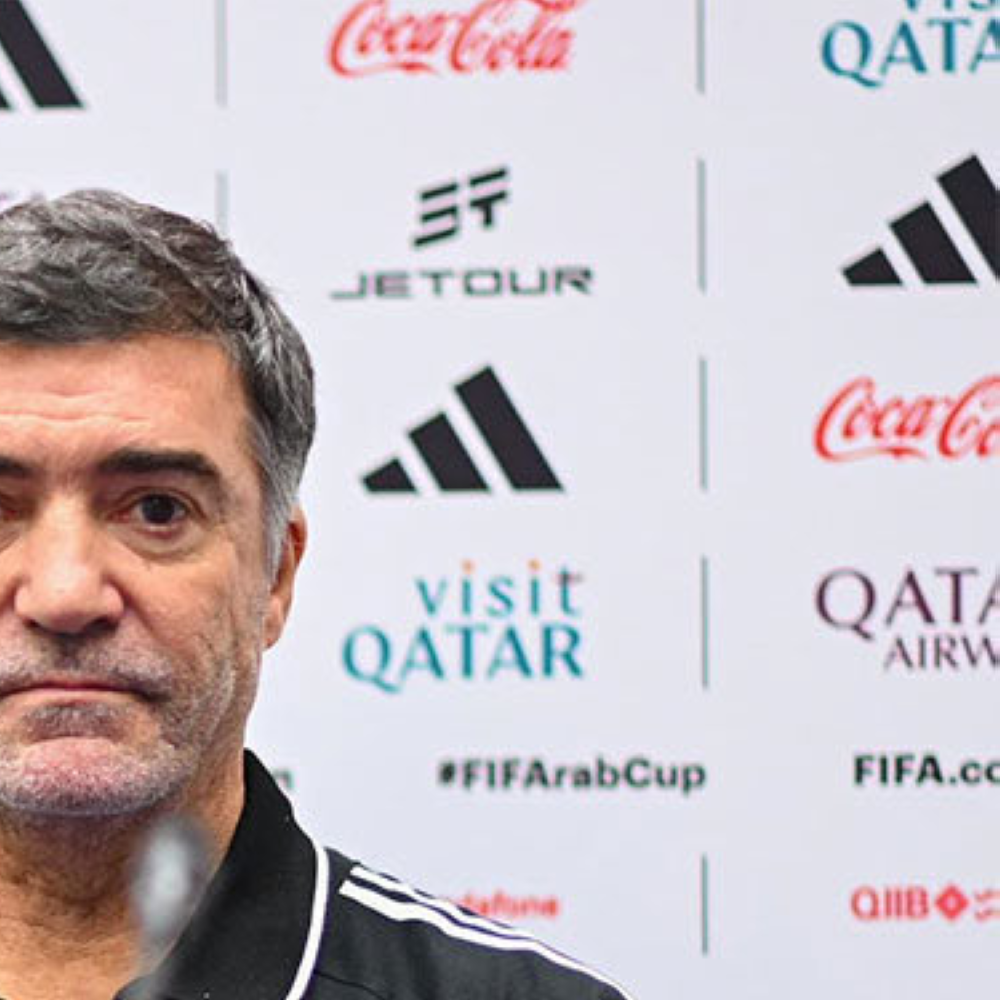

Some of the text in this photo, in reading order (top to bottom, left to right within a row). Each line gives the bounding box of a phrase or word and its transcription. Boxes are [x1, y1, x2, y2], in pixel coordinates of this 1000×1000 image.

[821, 18, 1000, 89] QATA
[330, 266, 595, 299] JETOUR
[415, 557, 583, 617] visit
[341, 624, 584, 693] QATAR
[884, 635, 1000, 670] AIRW
[437, 756, 707, 796] #FIFArabCup
[853, 754, 1000, 787] FIFA.co
